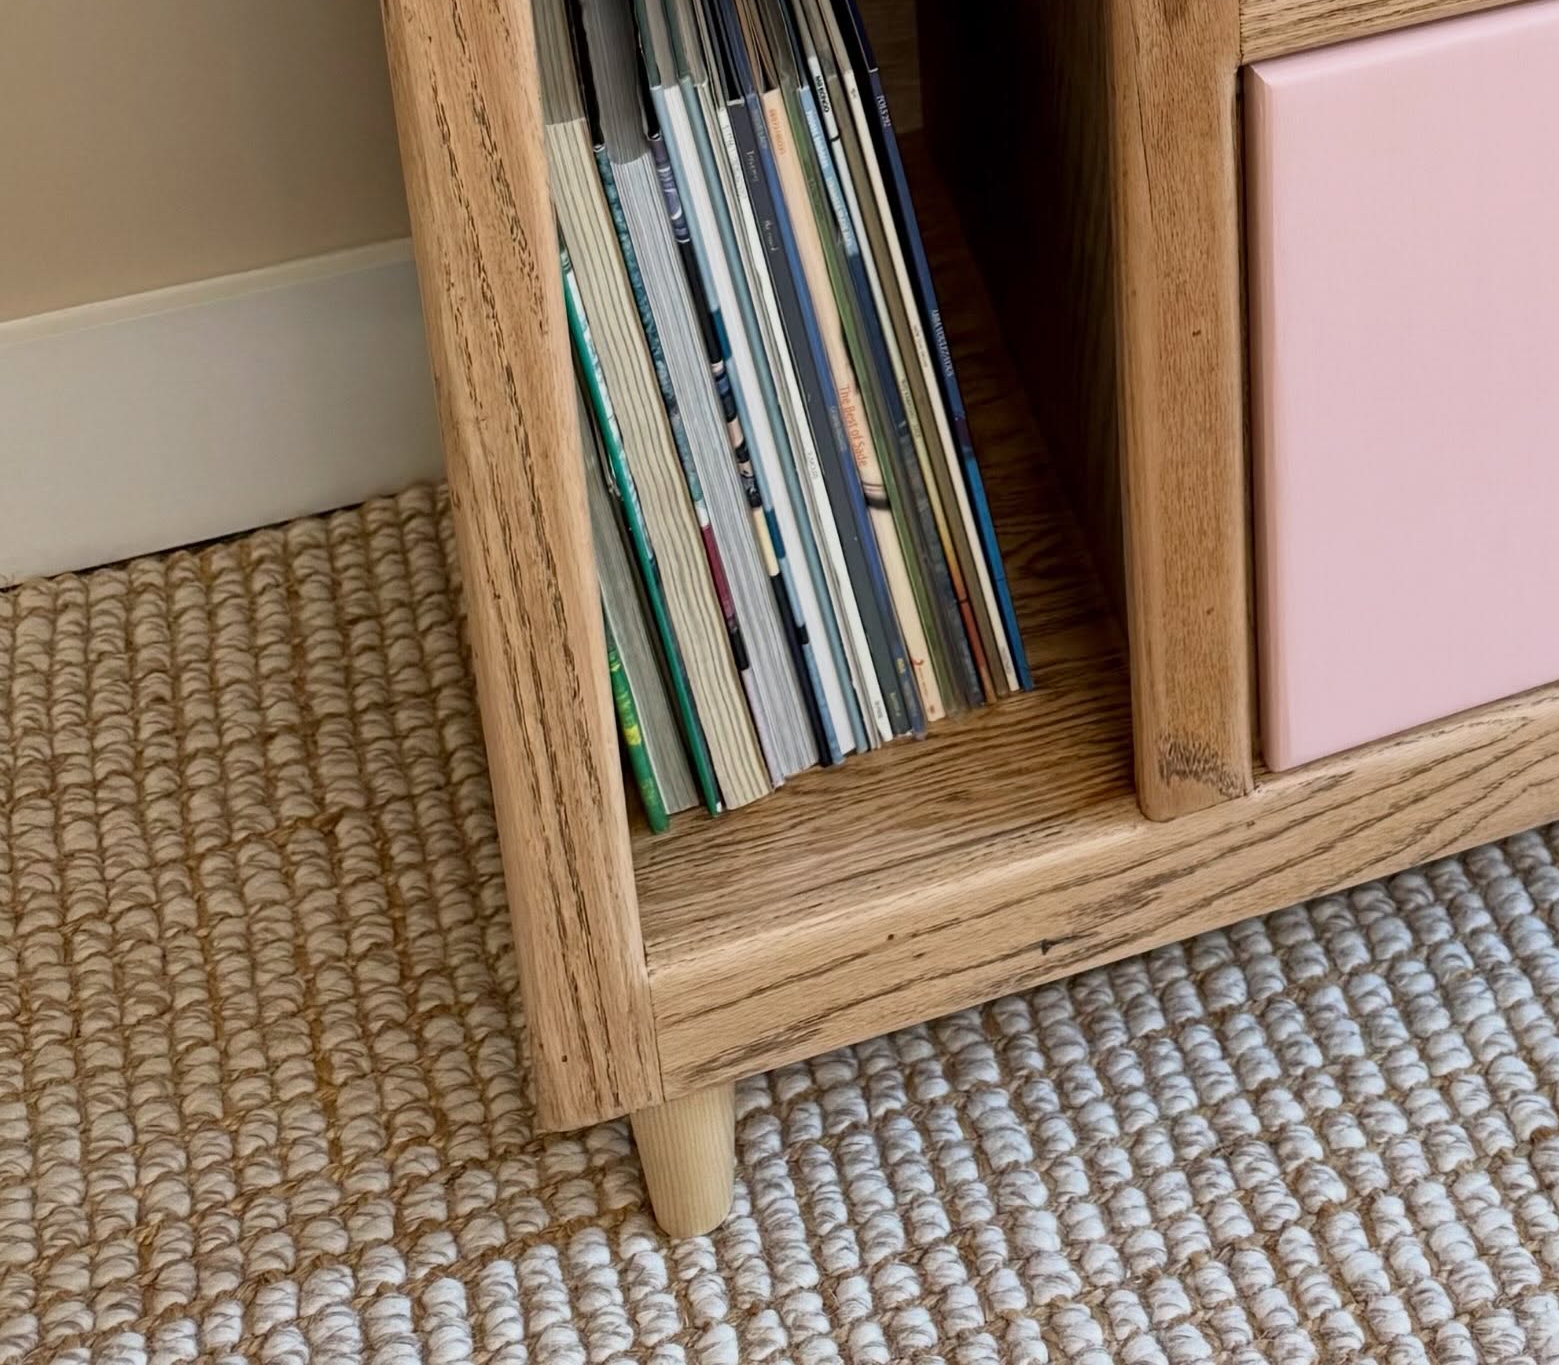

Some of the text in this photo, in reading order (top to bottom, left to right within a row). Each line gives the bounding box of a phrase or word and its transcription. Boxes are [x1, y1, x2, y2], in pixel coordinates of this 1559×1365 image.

[839, 383, 851, 405] The
[845, 405, 858, 429] Best
[854, 438, 869, 467] Sade
